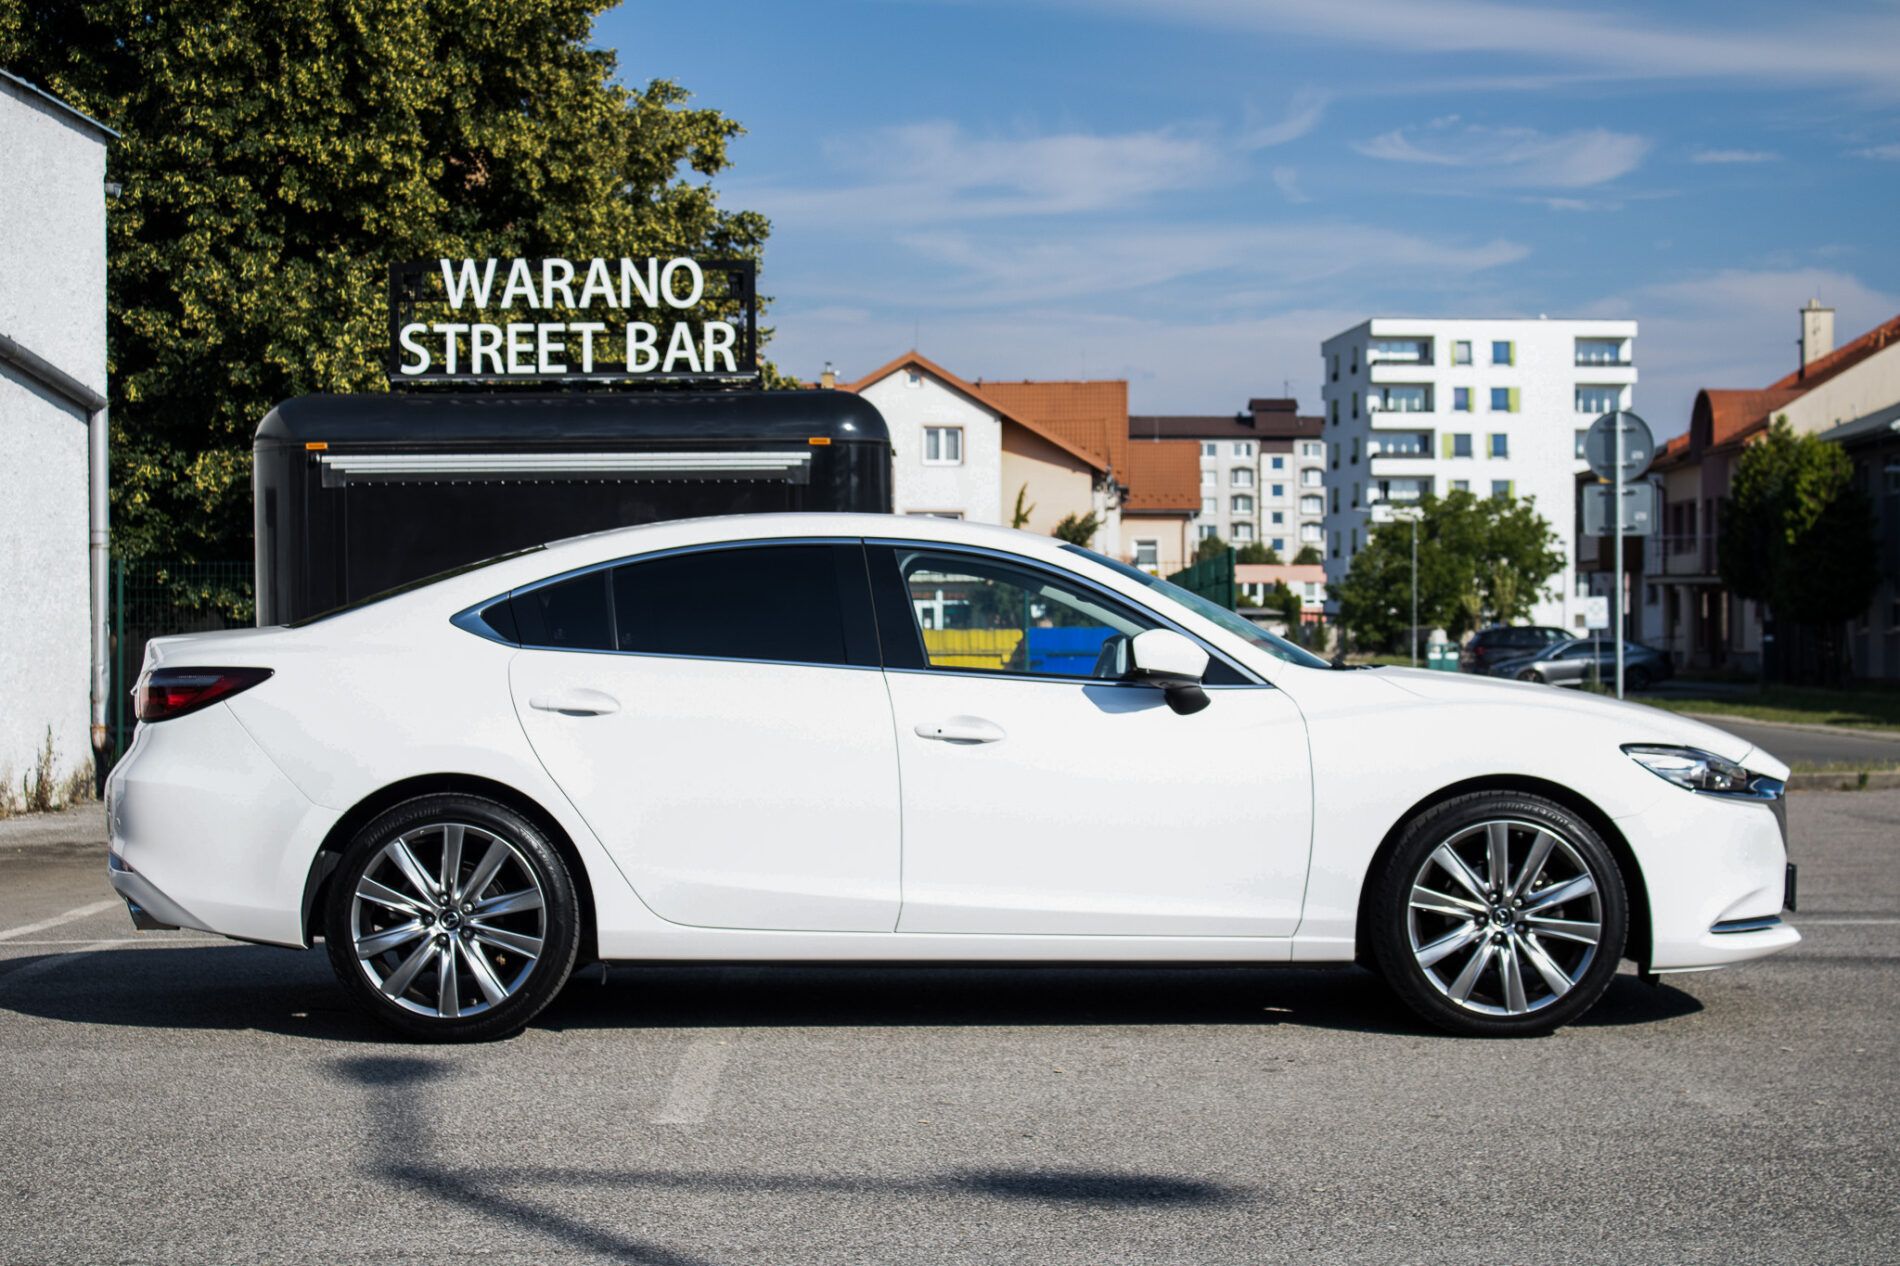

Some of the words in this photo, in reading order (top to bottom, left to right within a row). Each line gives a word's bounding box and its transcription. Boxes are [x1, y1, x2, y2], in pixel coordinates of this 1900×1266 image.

[440, 257, 704, 309] WARANO
[400, 322, 605, 375] STREET
[626, 321, 737, 374] BAR
